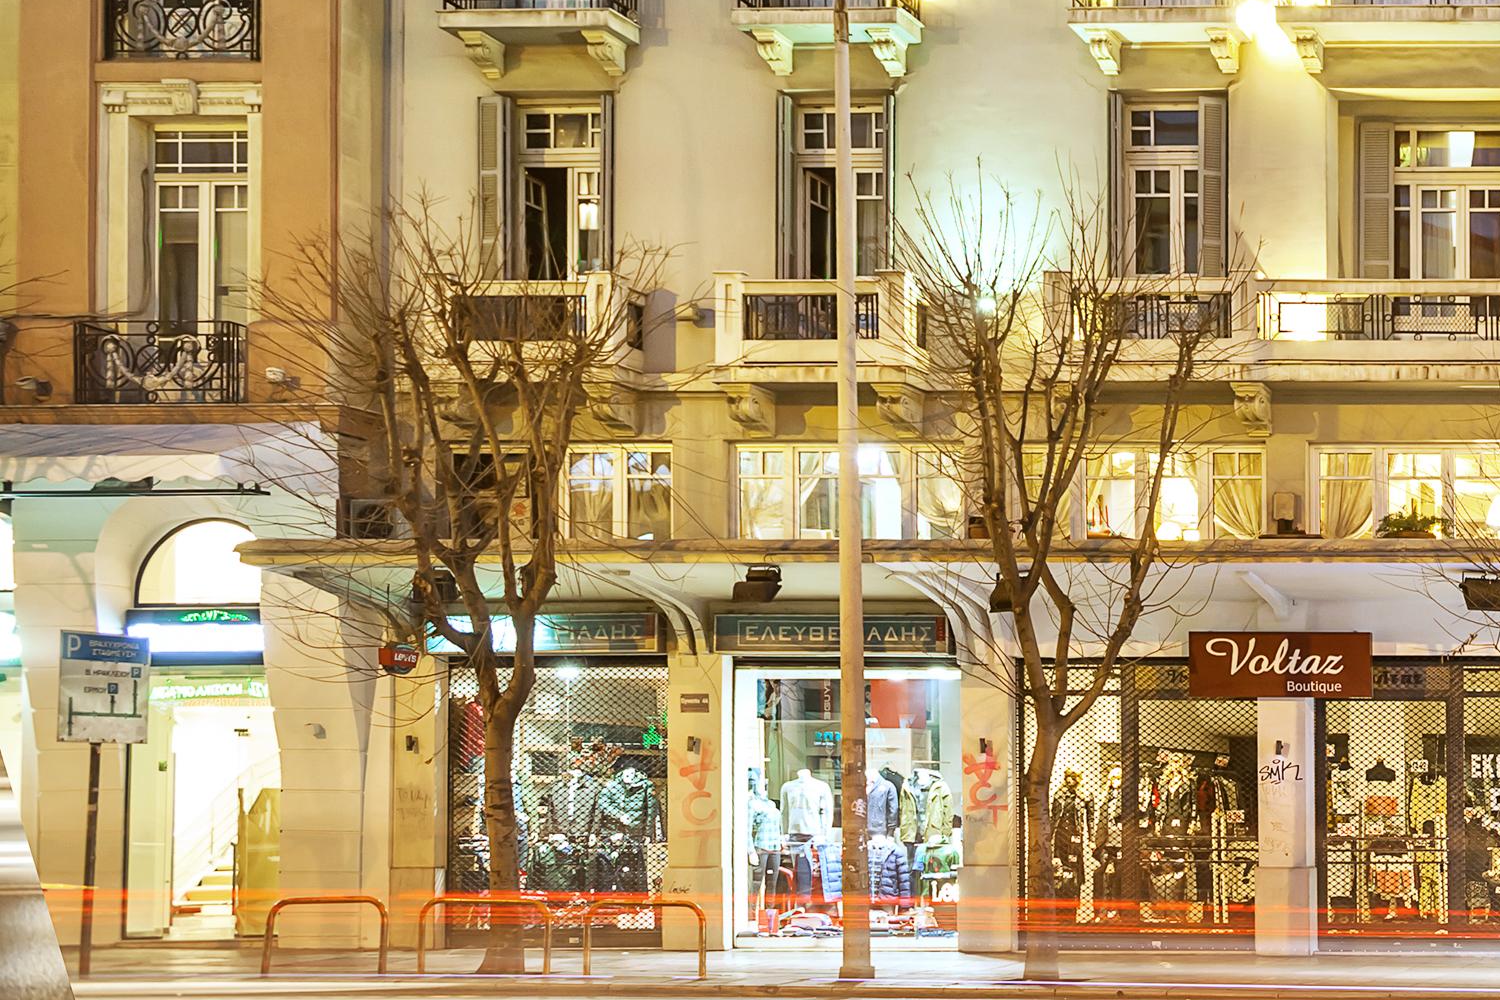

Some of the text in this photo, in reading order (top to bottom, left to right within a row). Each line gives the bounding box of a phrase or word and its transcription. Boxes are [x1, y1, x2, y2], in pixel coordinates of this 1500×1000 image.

[745, 625, 932, 642] ΕΛΕΥΘΕΑΔΗΣ
[1206, 637, 1344, 676] Voltaz
[1286, 680, 1342, 693] Boutique
